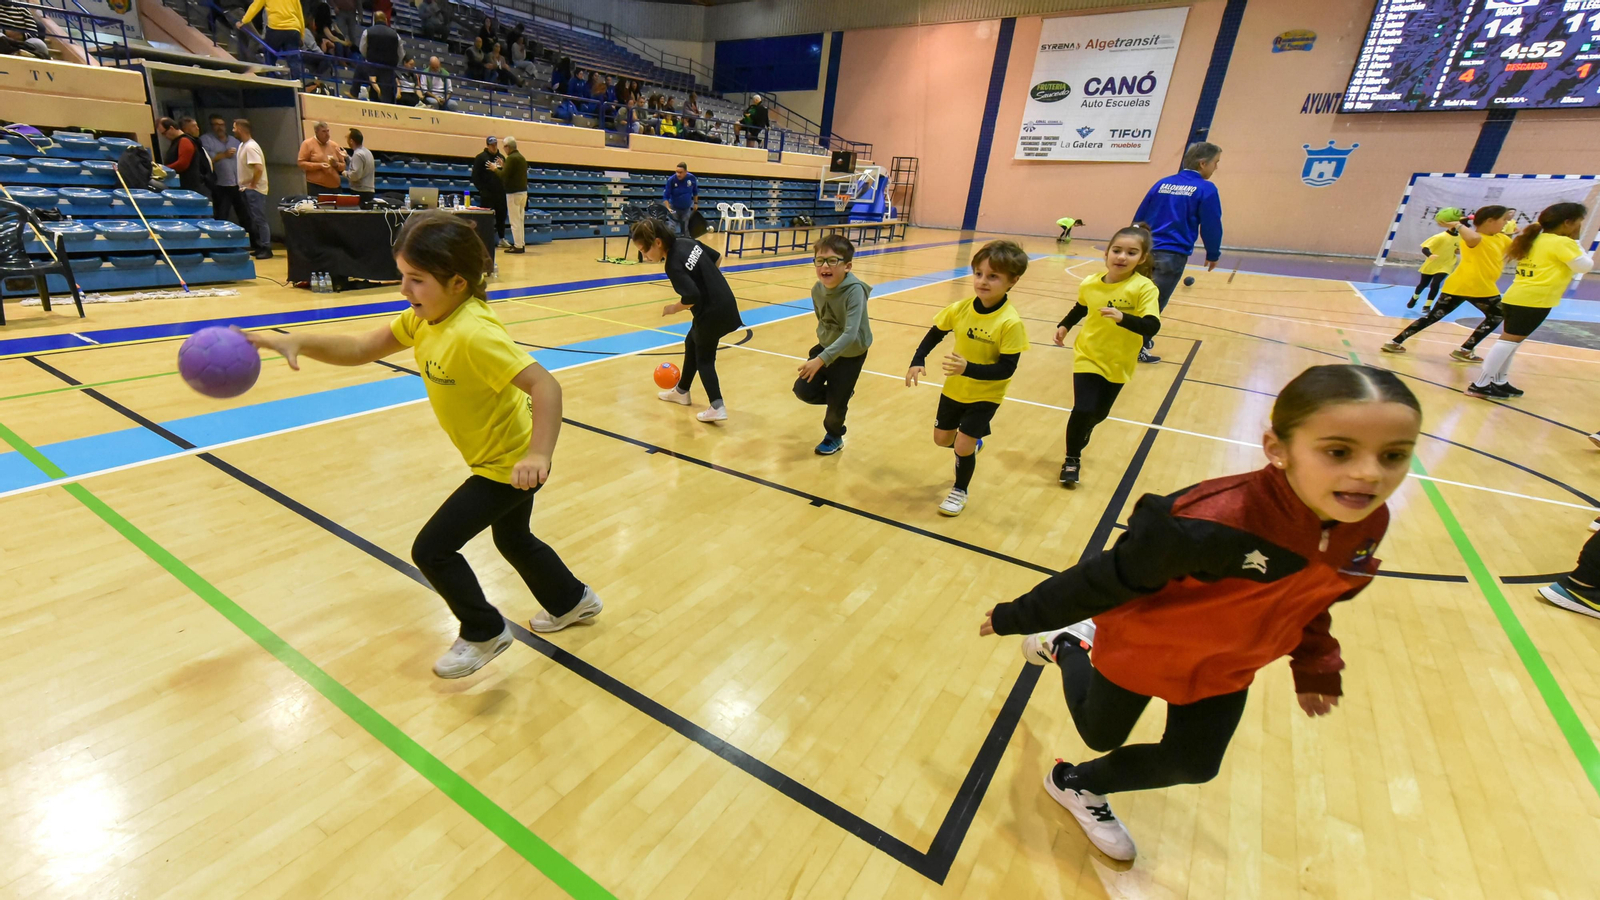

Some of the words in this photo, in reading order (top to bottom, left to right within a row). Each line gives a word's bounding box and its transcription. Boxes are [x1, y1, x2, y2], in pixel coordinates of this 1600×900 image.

[1484, 17, 1524, 38] 14
[1085, 35, 1160, 51] Algetransit
[1500, 41, 1566, 60] 4:52
[1505, 62, 1548, 71] DESCANSO
[1576, 63, 1592, 78] 1
[30, 70, 54, 82] TV
[1458, 68, 1475, 82] 4
[1084, 71, 1157, 96] CANÓ
[1081, 100, 1103, 108] Auto
[1106, 98, 1150, 108] Escuelas
[362, 108, 398, 120] PRENSA
